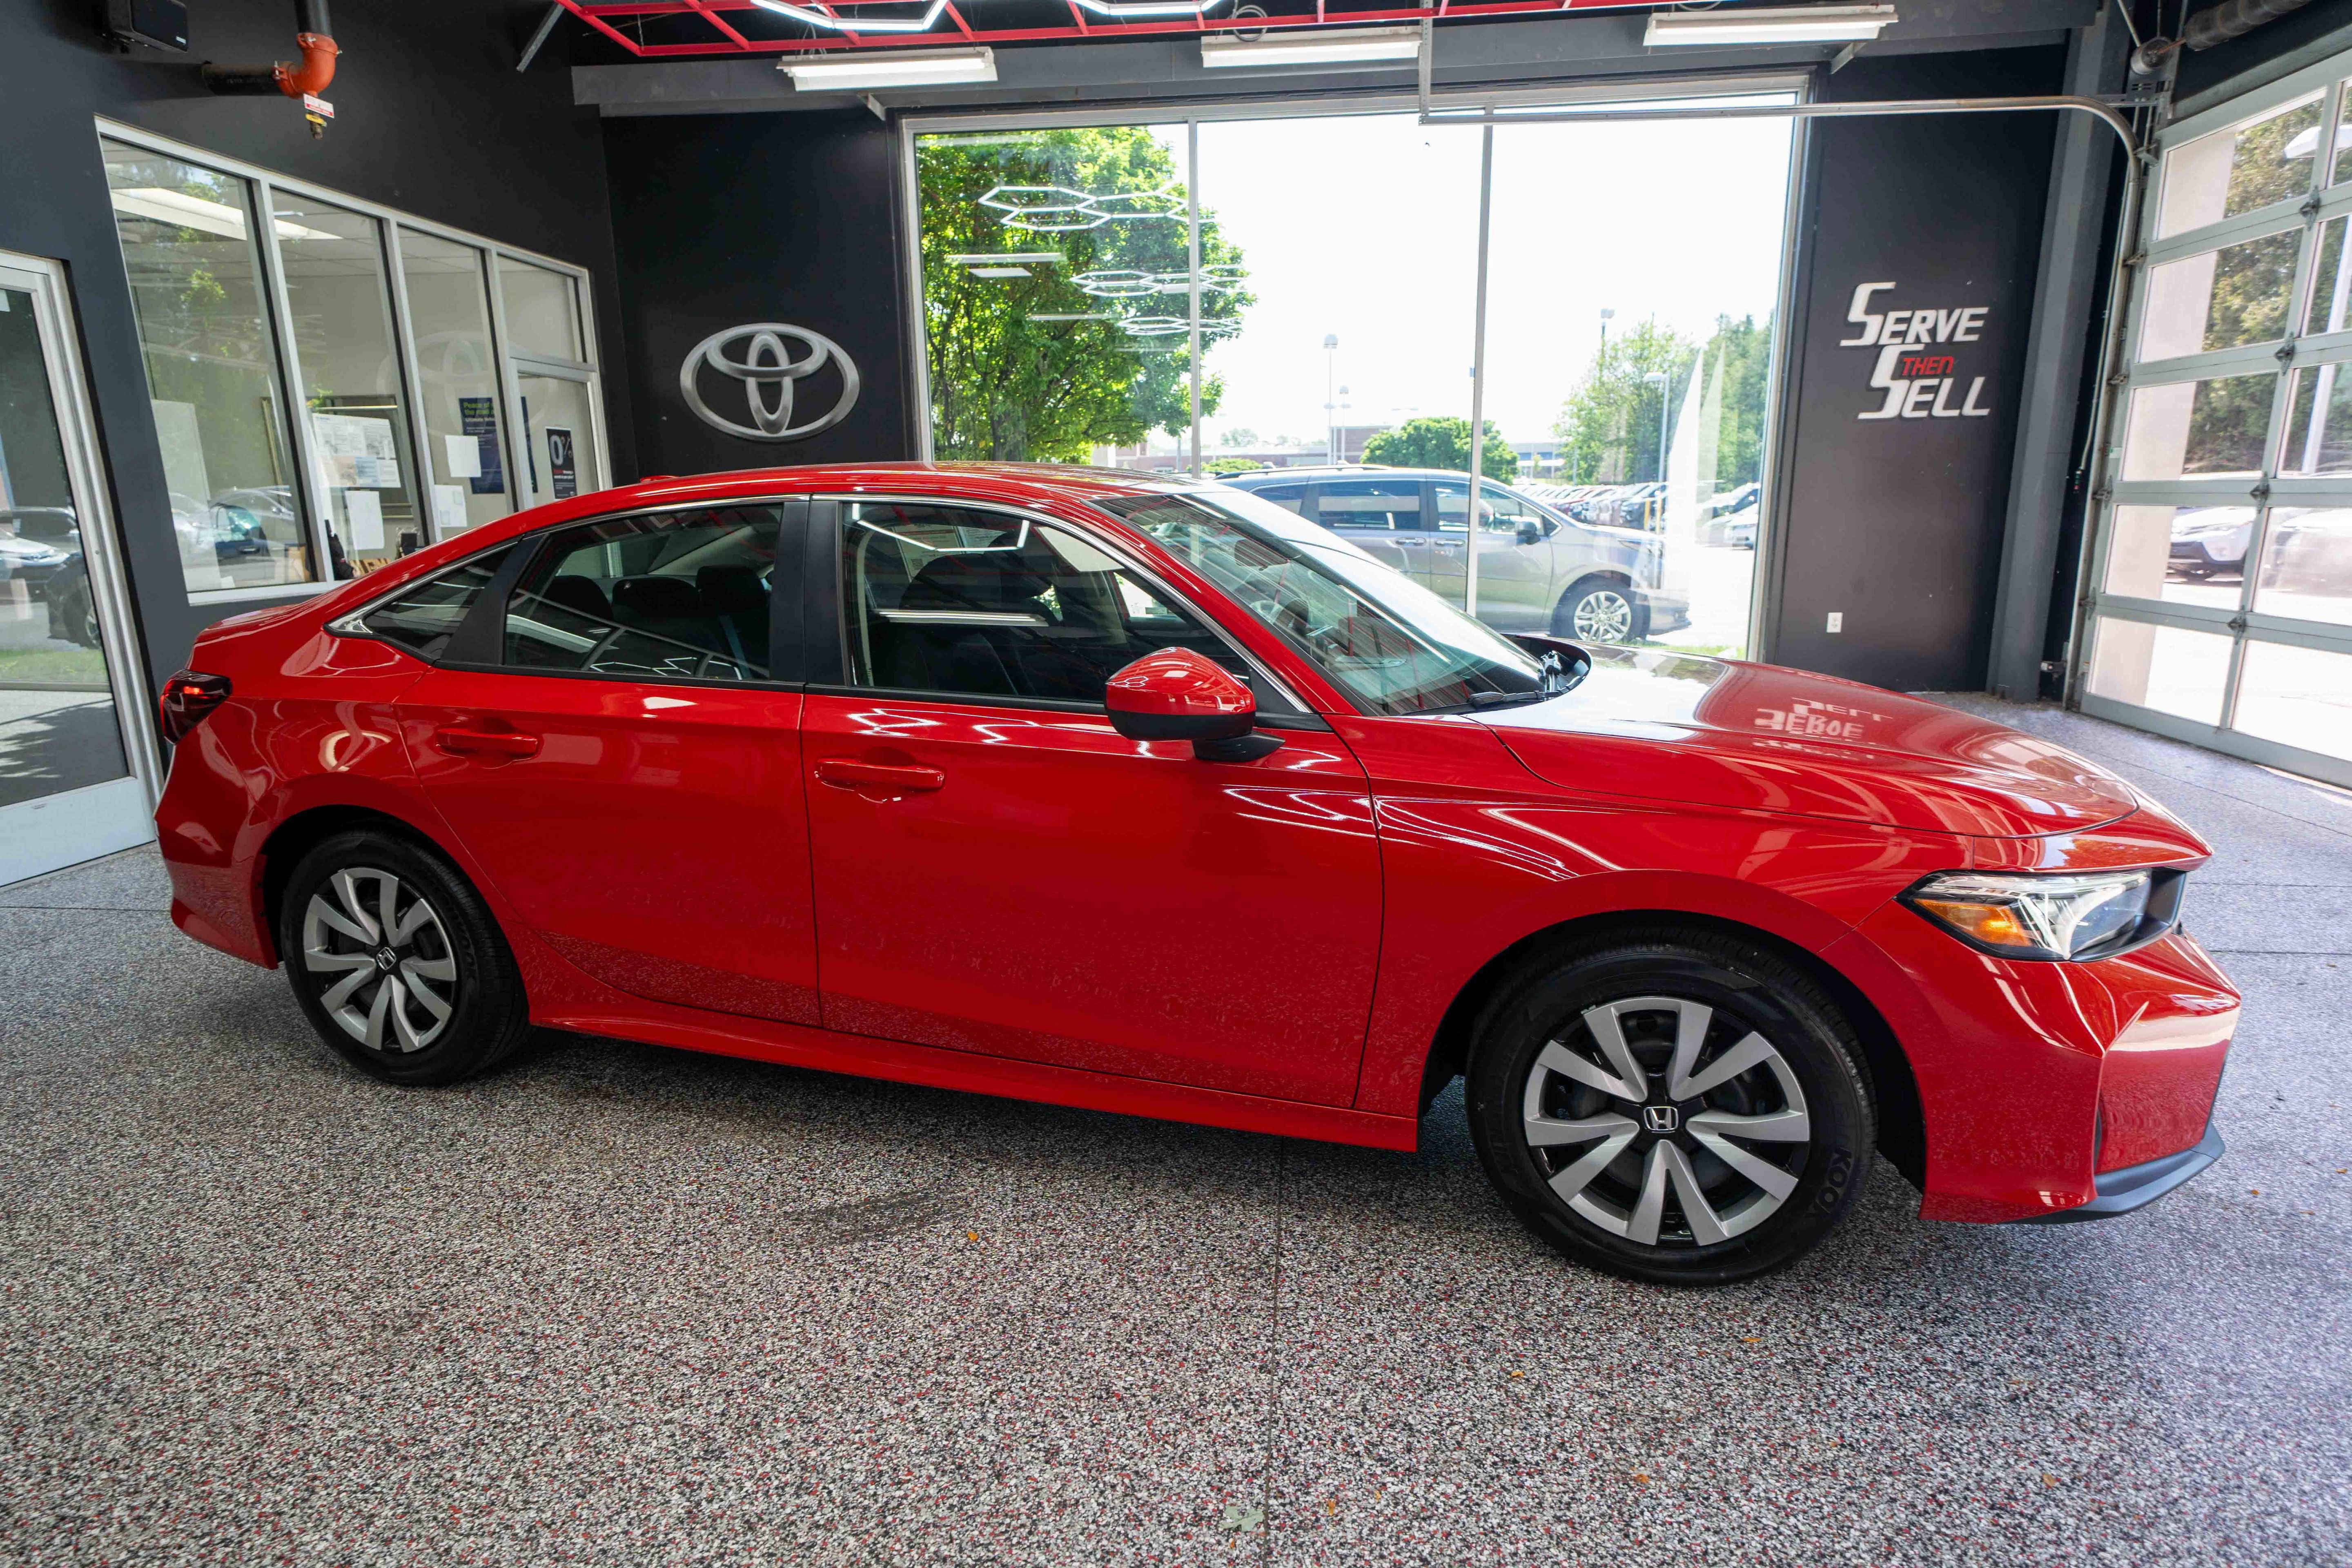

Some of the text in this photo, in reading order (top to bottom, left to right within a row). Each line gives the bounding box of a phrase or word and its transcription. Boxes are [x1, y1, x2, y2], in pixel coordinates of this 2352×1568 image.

[1840, 282, 1989, 346] SERVE
[1857, 343, 1991, 419] SELL
[549, 434, 573, 466] 0%
